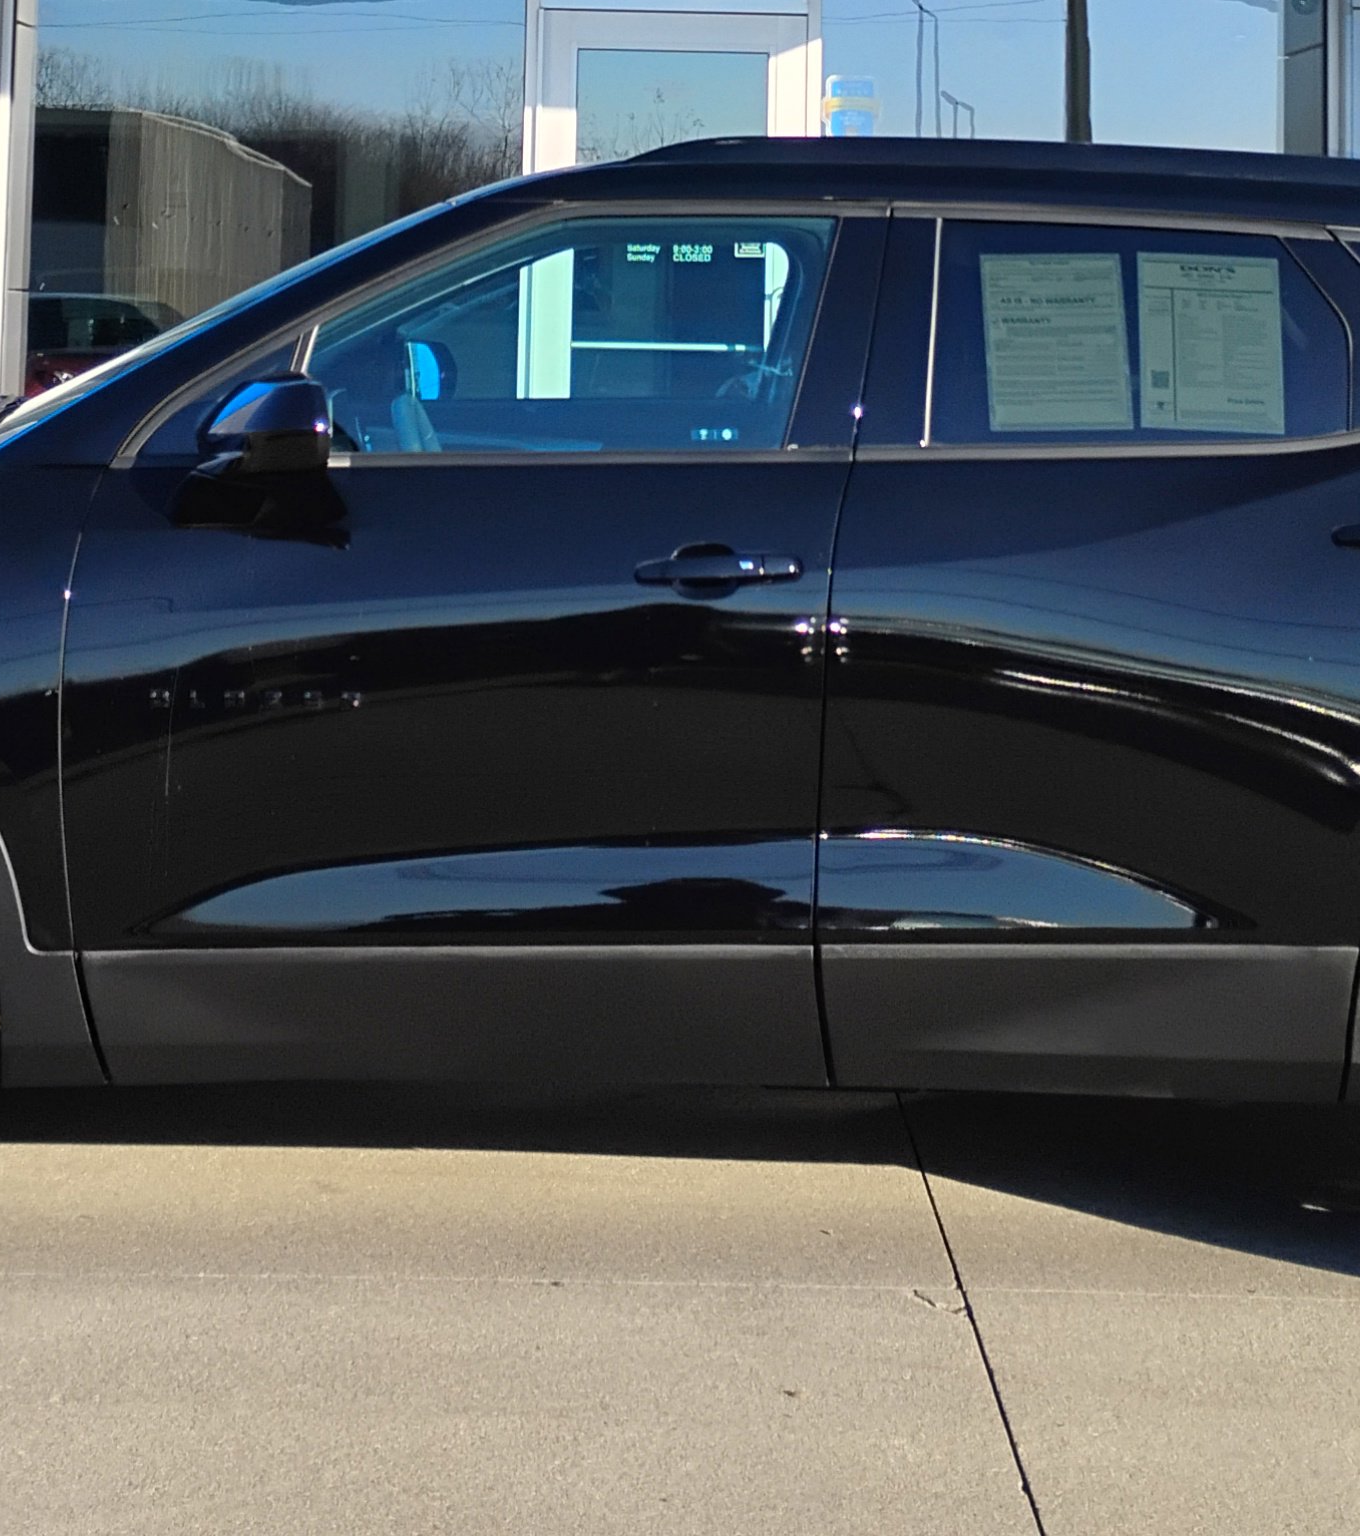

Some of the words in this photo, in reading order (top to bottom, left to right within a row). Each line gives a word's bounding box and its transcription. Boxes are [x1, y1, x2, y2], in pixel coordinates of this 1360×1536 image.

[627, 253, 655, 263] Sunday
[673, 254, 711, 262] CLOSED
[1045, 296, 1095, 304] WARRANTY
